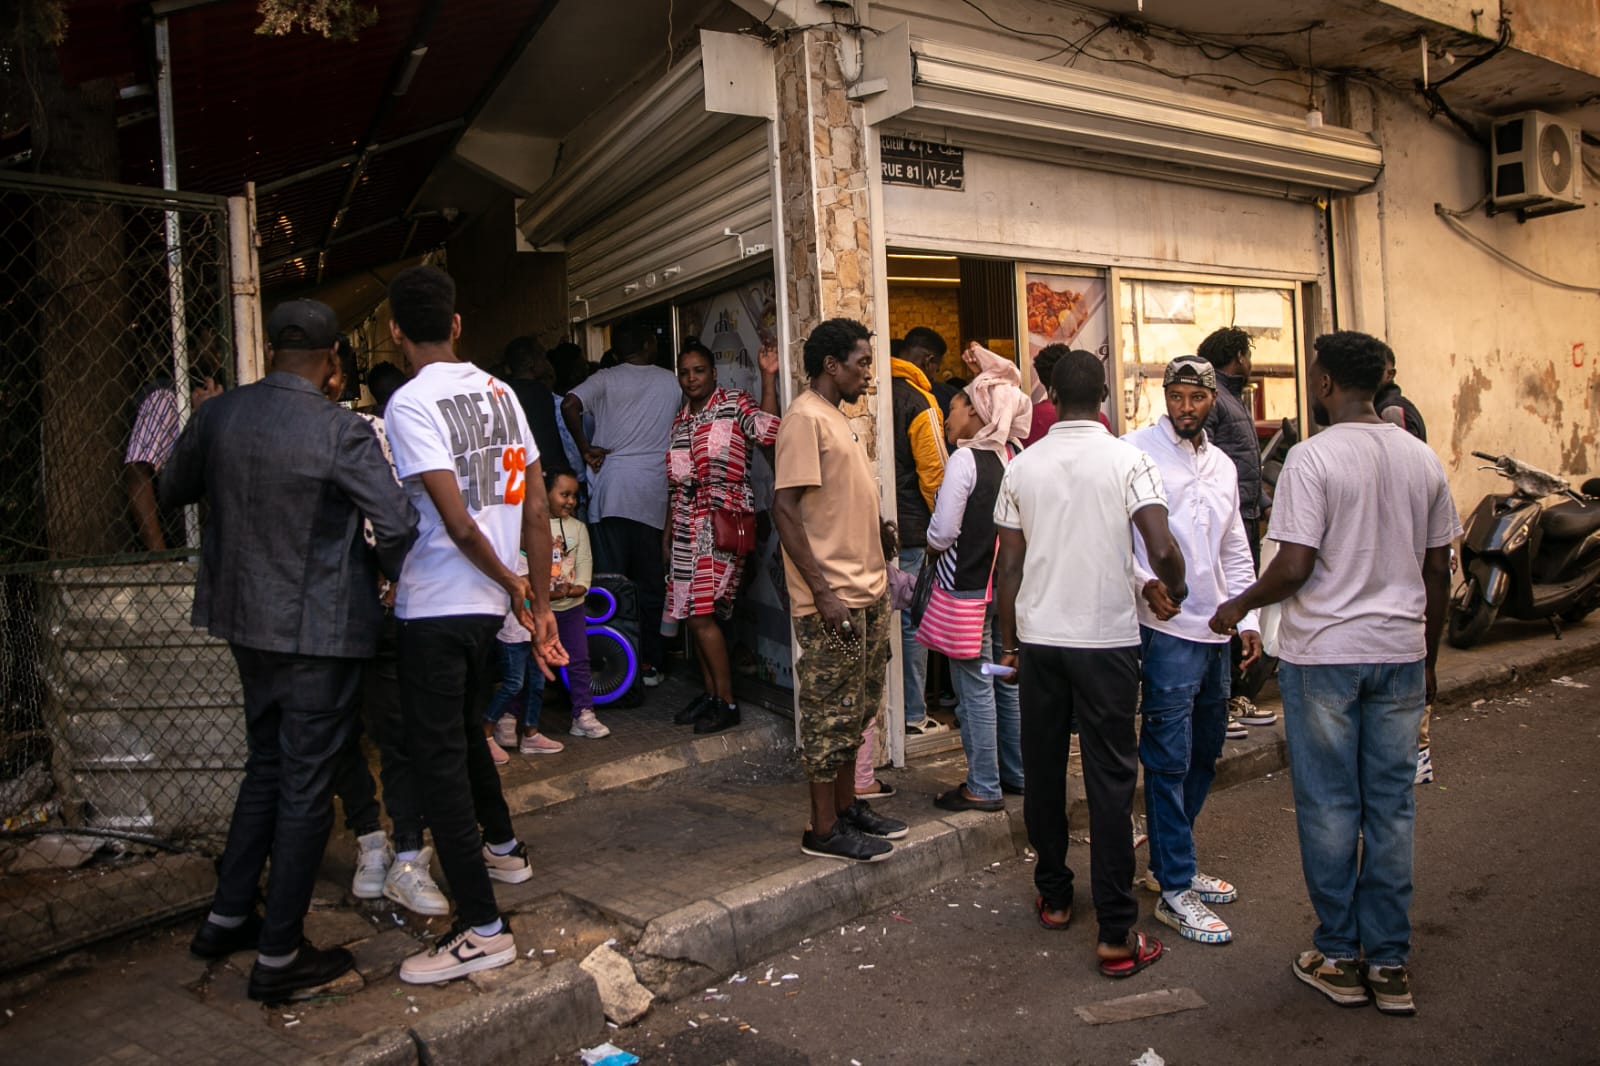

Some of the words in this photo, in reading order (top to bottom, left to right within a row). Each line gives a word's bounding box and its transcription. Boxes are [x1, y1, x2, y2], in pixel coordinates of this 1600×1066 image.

[881, 162, 903, 178] RUE
[906, 165, 920, 180] 81
[436, 391, 523, 456] DREAM
